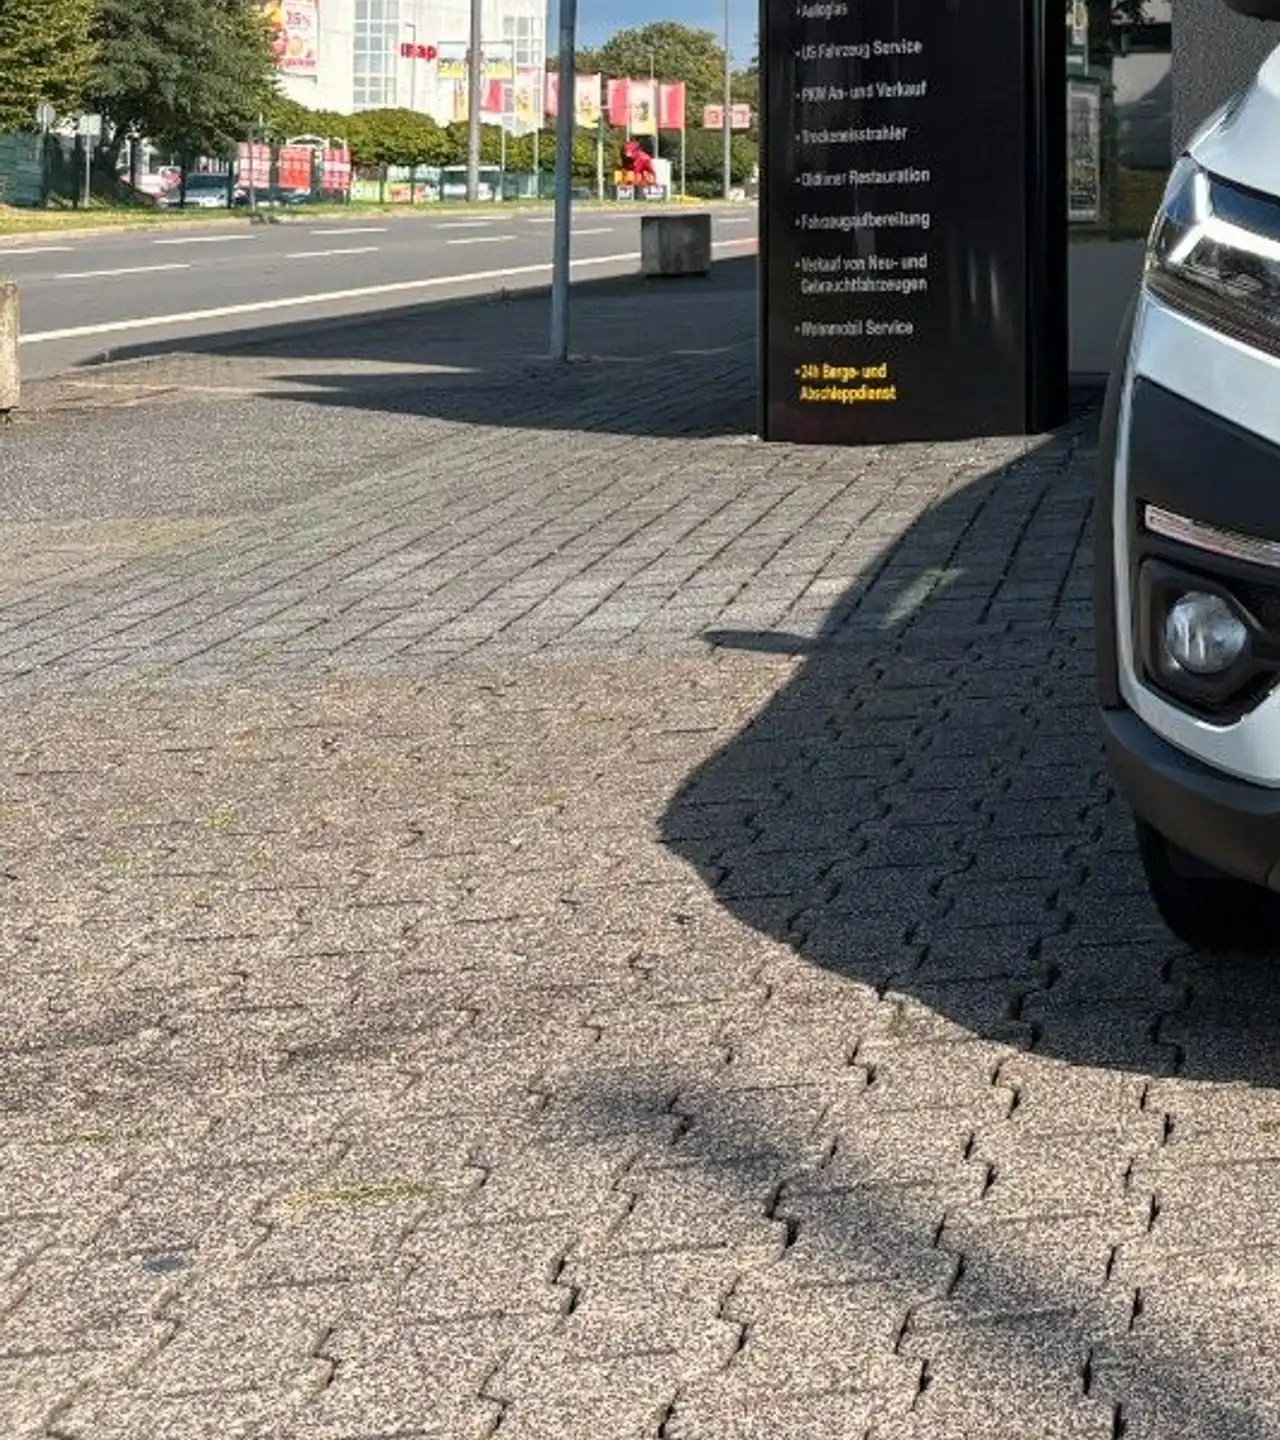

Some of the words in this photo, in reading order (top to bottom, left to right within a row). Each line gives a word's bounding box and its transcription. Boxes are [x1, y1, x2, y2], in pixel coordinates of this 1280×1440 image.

[801, 1, 849, 20] Autoglas
[801, 44, 818, 61] US
[818, 41, 871, 60] Fahrzeug
[872, 38, 924, 56] Service
[850, 82, 874, 99] und
[875, 79, 929, 98] Verkauf
[848, 167, 931, 185] Restauration
[801, 211, 931, 232] Fahrzeugaufbereitung
[801, 256, 842, 273] Verkauf
[843, 258, 866, 271] von
[867, 254, 900, 271] Neu-
[901, 254, 929, 269] und
[800, 276, 929, 296] Gebrauchtfahrzeugen
[801, 320, 863, 337] Wohnmobil
[865, 319, 915, 336] Service
[861, 362, 888, 379] und
[800, 385, 898, 405] Abschleppdienst
